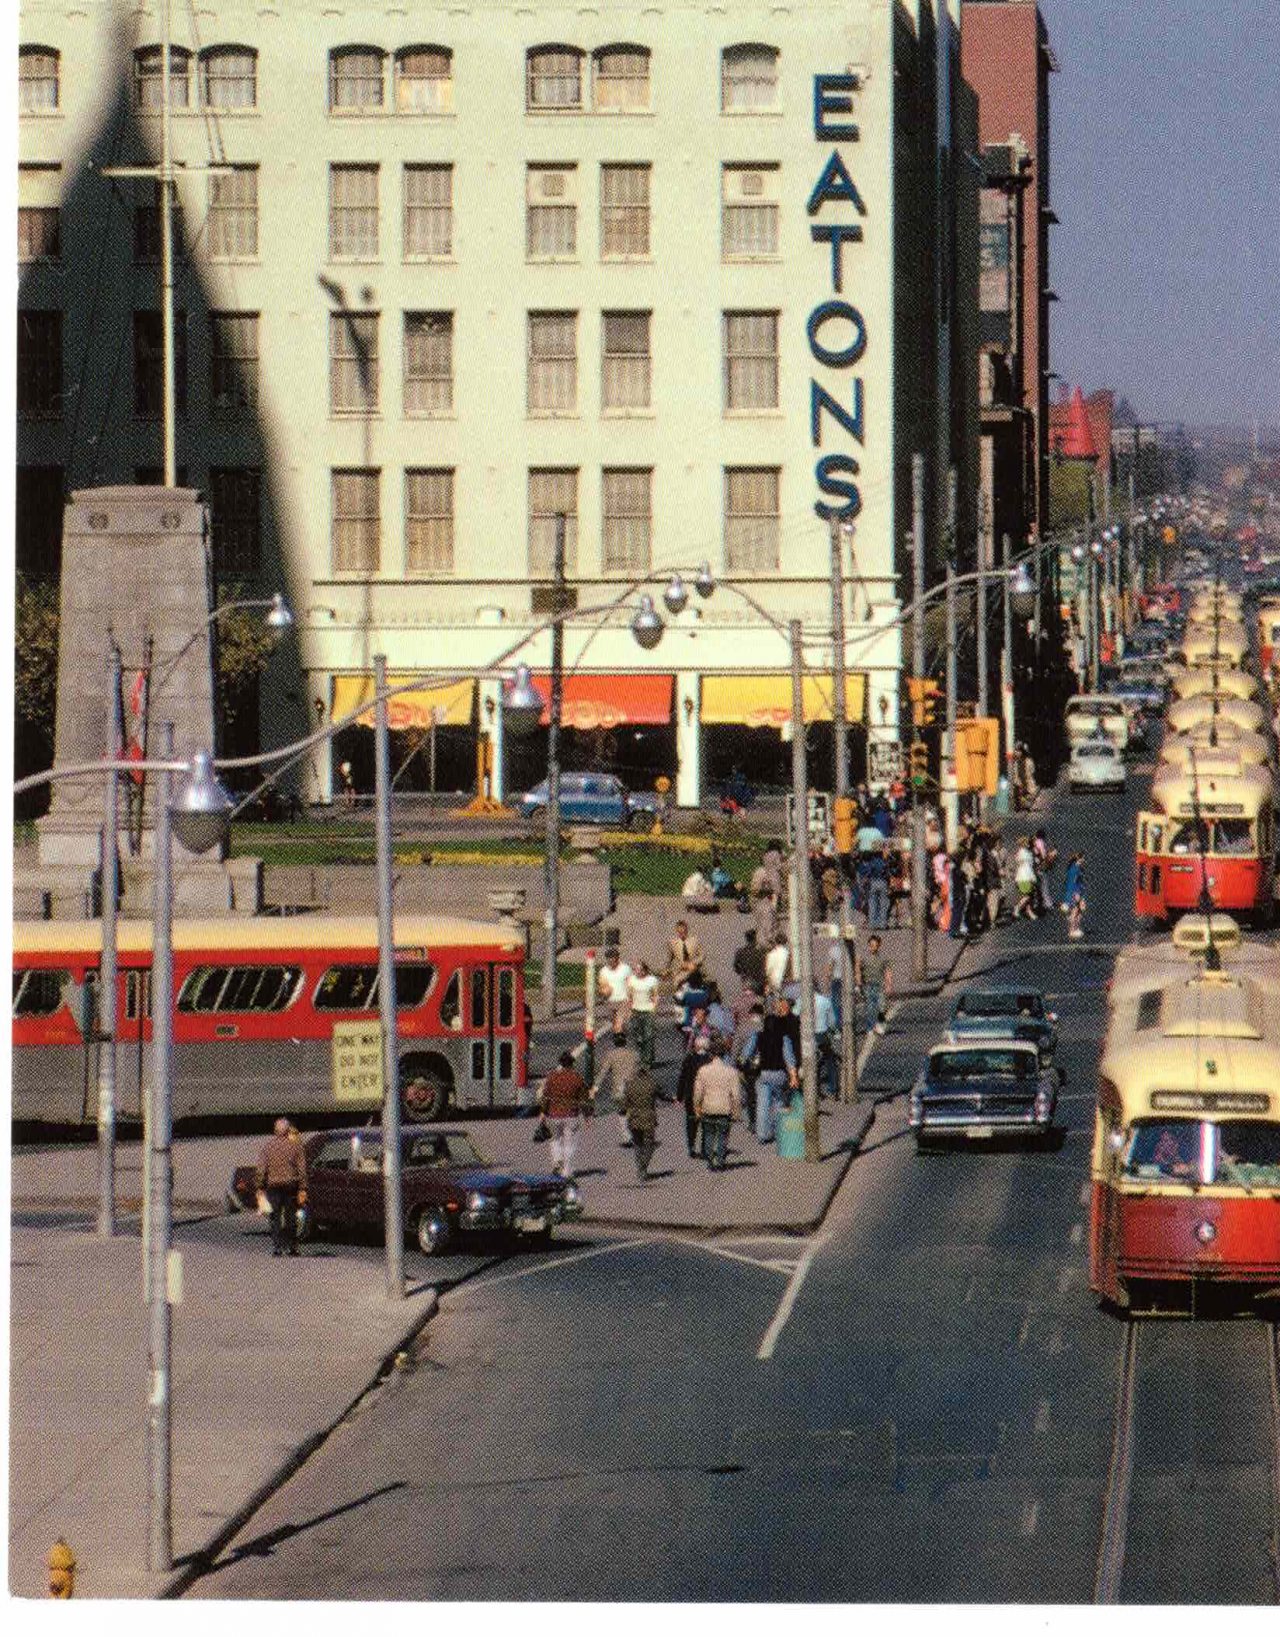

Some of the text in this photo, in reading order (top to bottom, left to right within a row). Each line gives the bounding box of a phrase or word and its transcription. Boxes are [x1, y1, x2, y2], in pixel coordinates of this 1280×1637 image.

[806, 74, 868, 520] EATONS
[336, 1033, 380, 1047] ONE WAY
[340, 1054, 378, 1068] DO NOT
[341, 1073, 378, 1088] ENTER
